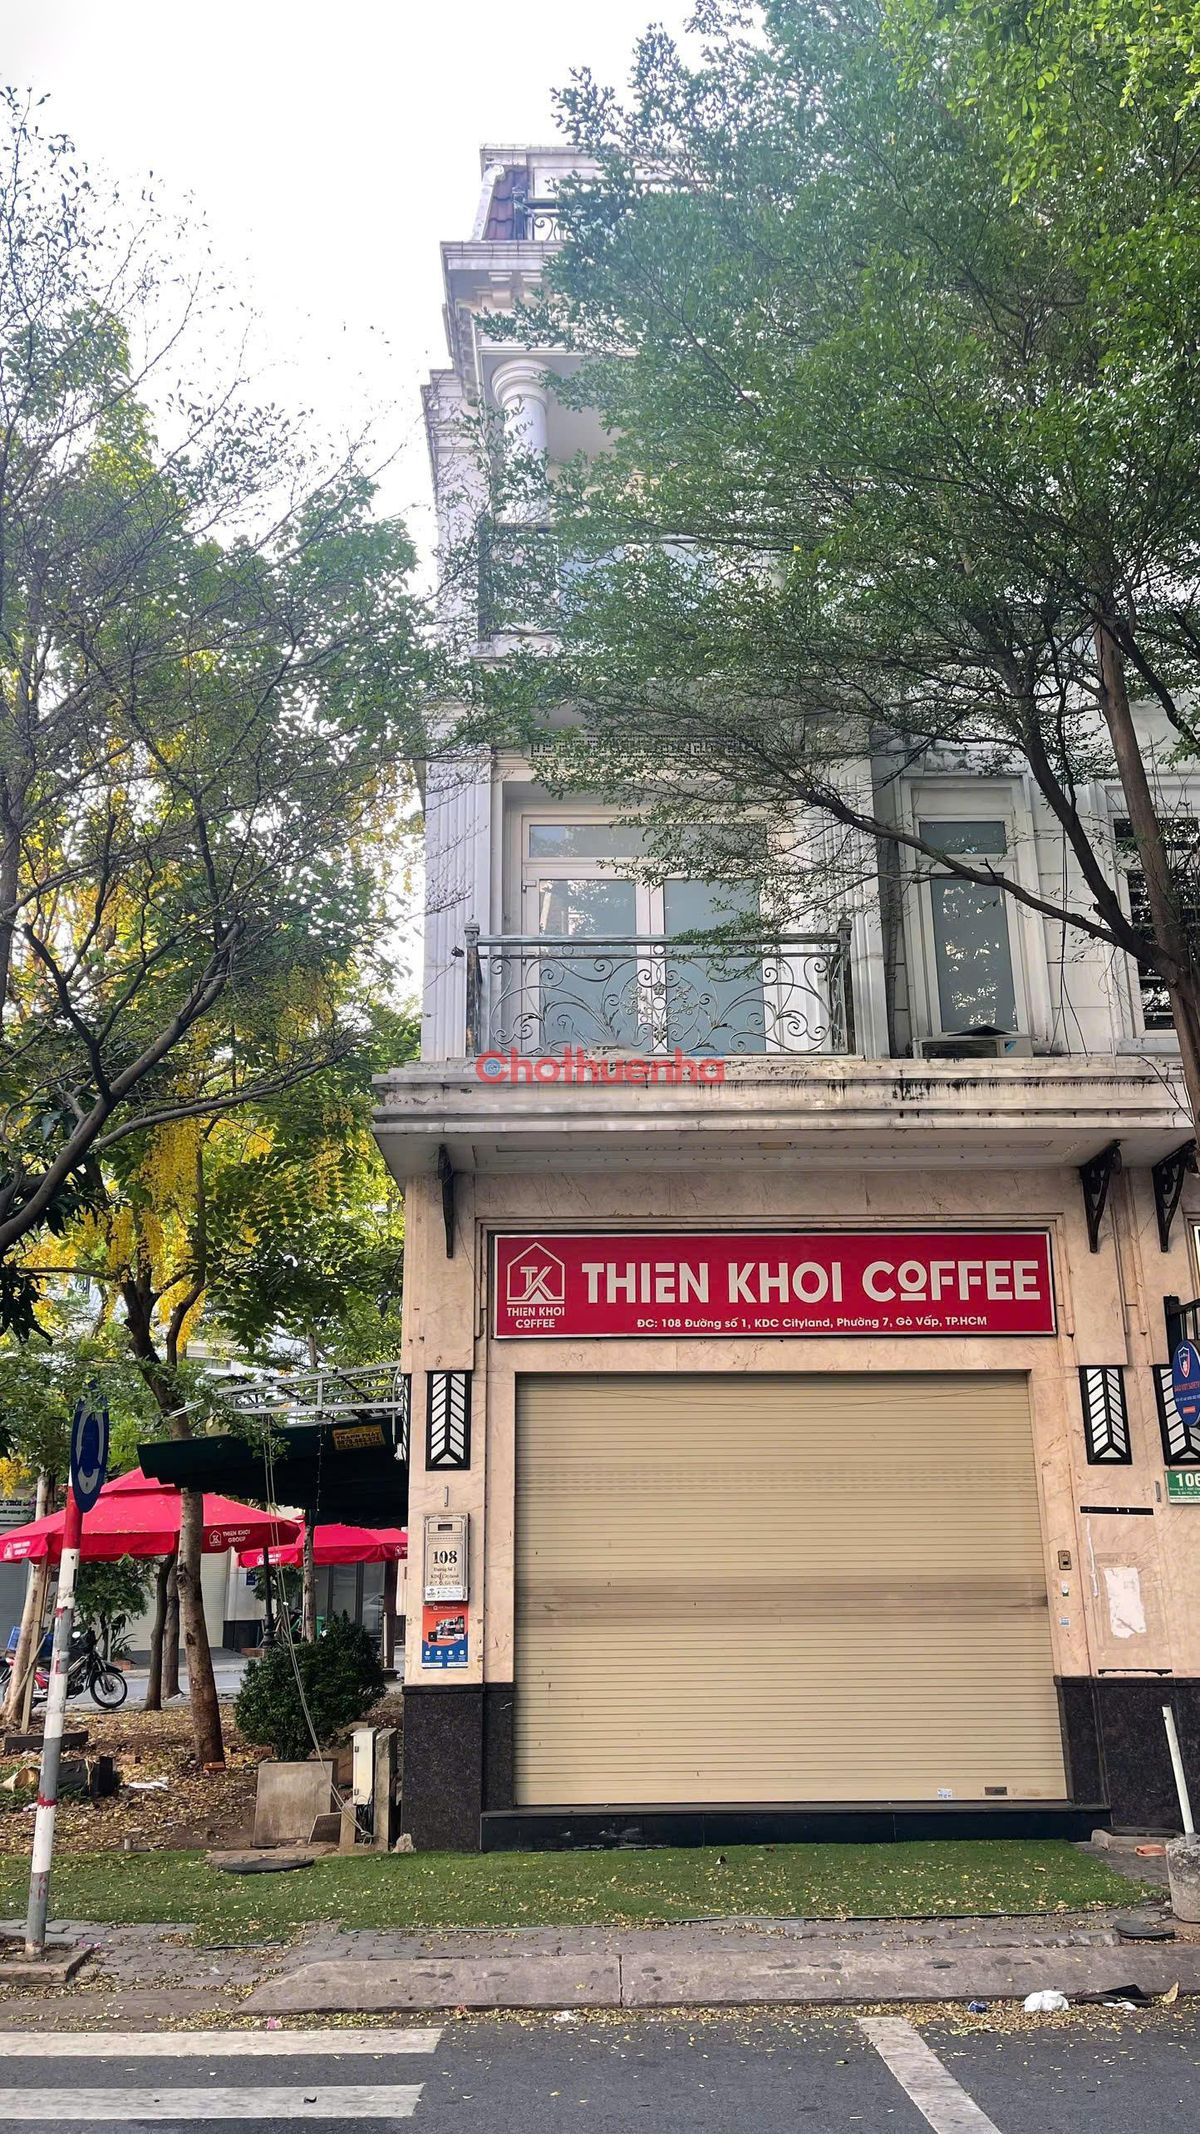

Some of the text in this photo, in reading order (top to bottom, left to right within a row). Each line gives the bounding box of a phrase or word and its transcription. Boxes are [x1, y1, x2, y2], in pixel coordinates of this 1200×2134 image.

[581, 1260, 1041, 1304] THIEN KHOI COFFEE
[506, 1306, 565, 1317] THIEN KHOI
[515, 1318, 556, 1329] COFFEE
[636, 1315, 988, 1330] ĐC: 108 Đường số 1, KDC Cityland, Phường 7, Gò Vấp, TP.HCM
[432, 1550, 458, 1564] 108
